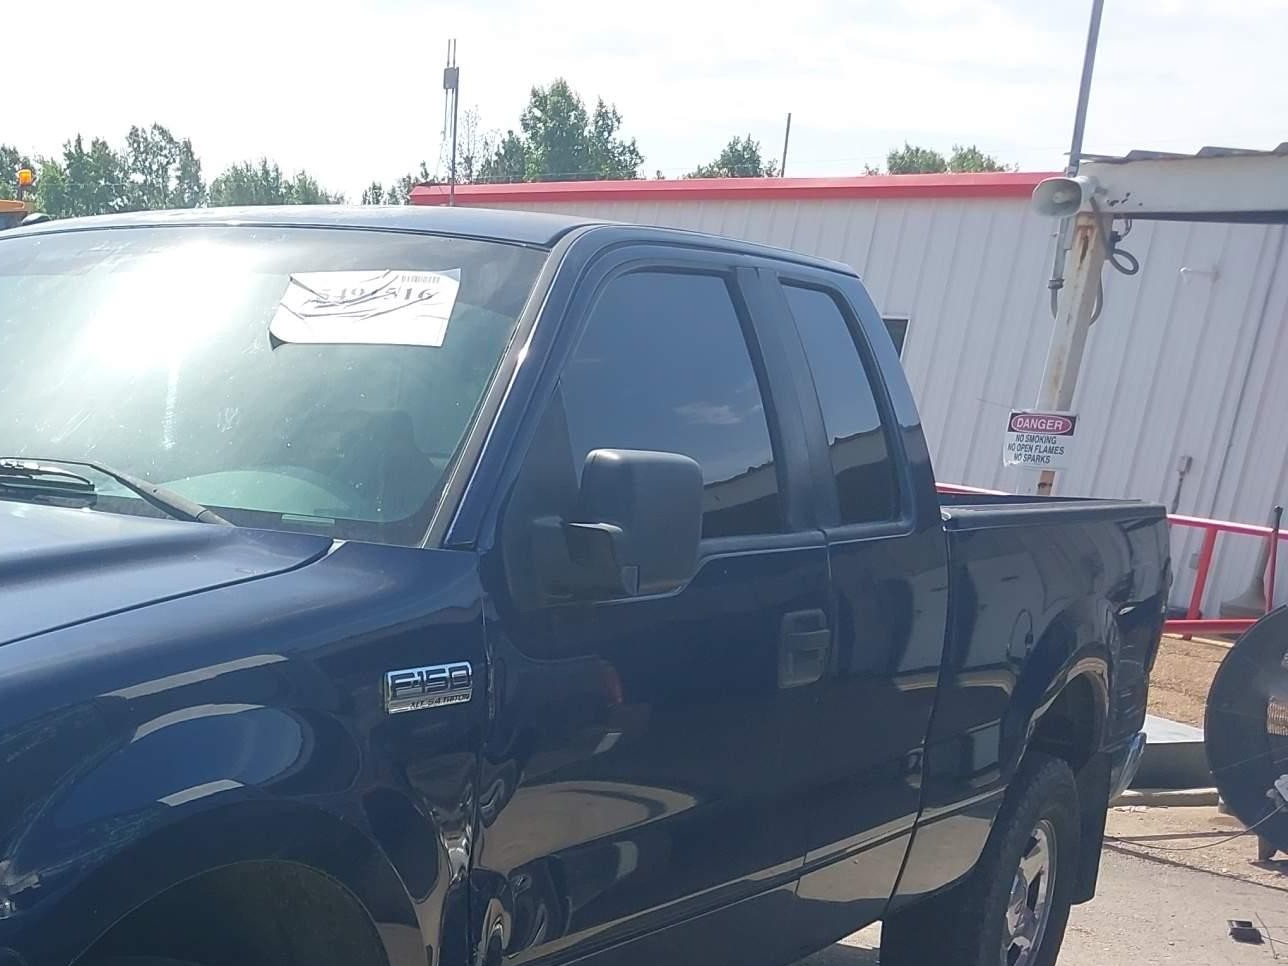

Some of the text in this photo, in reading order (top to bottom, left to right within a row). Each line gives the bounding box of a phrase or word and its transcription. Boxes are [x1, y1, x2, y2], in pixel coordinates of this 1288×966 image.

[1016, 418, 1063, 430] DANGER
[1016, 434, 1057, 444] NO SMOKING
[1008, 443, 1064, 455] NO OPEN FLAMES
[1014, 452, 1050, 464] NO SPARKS
